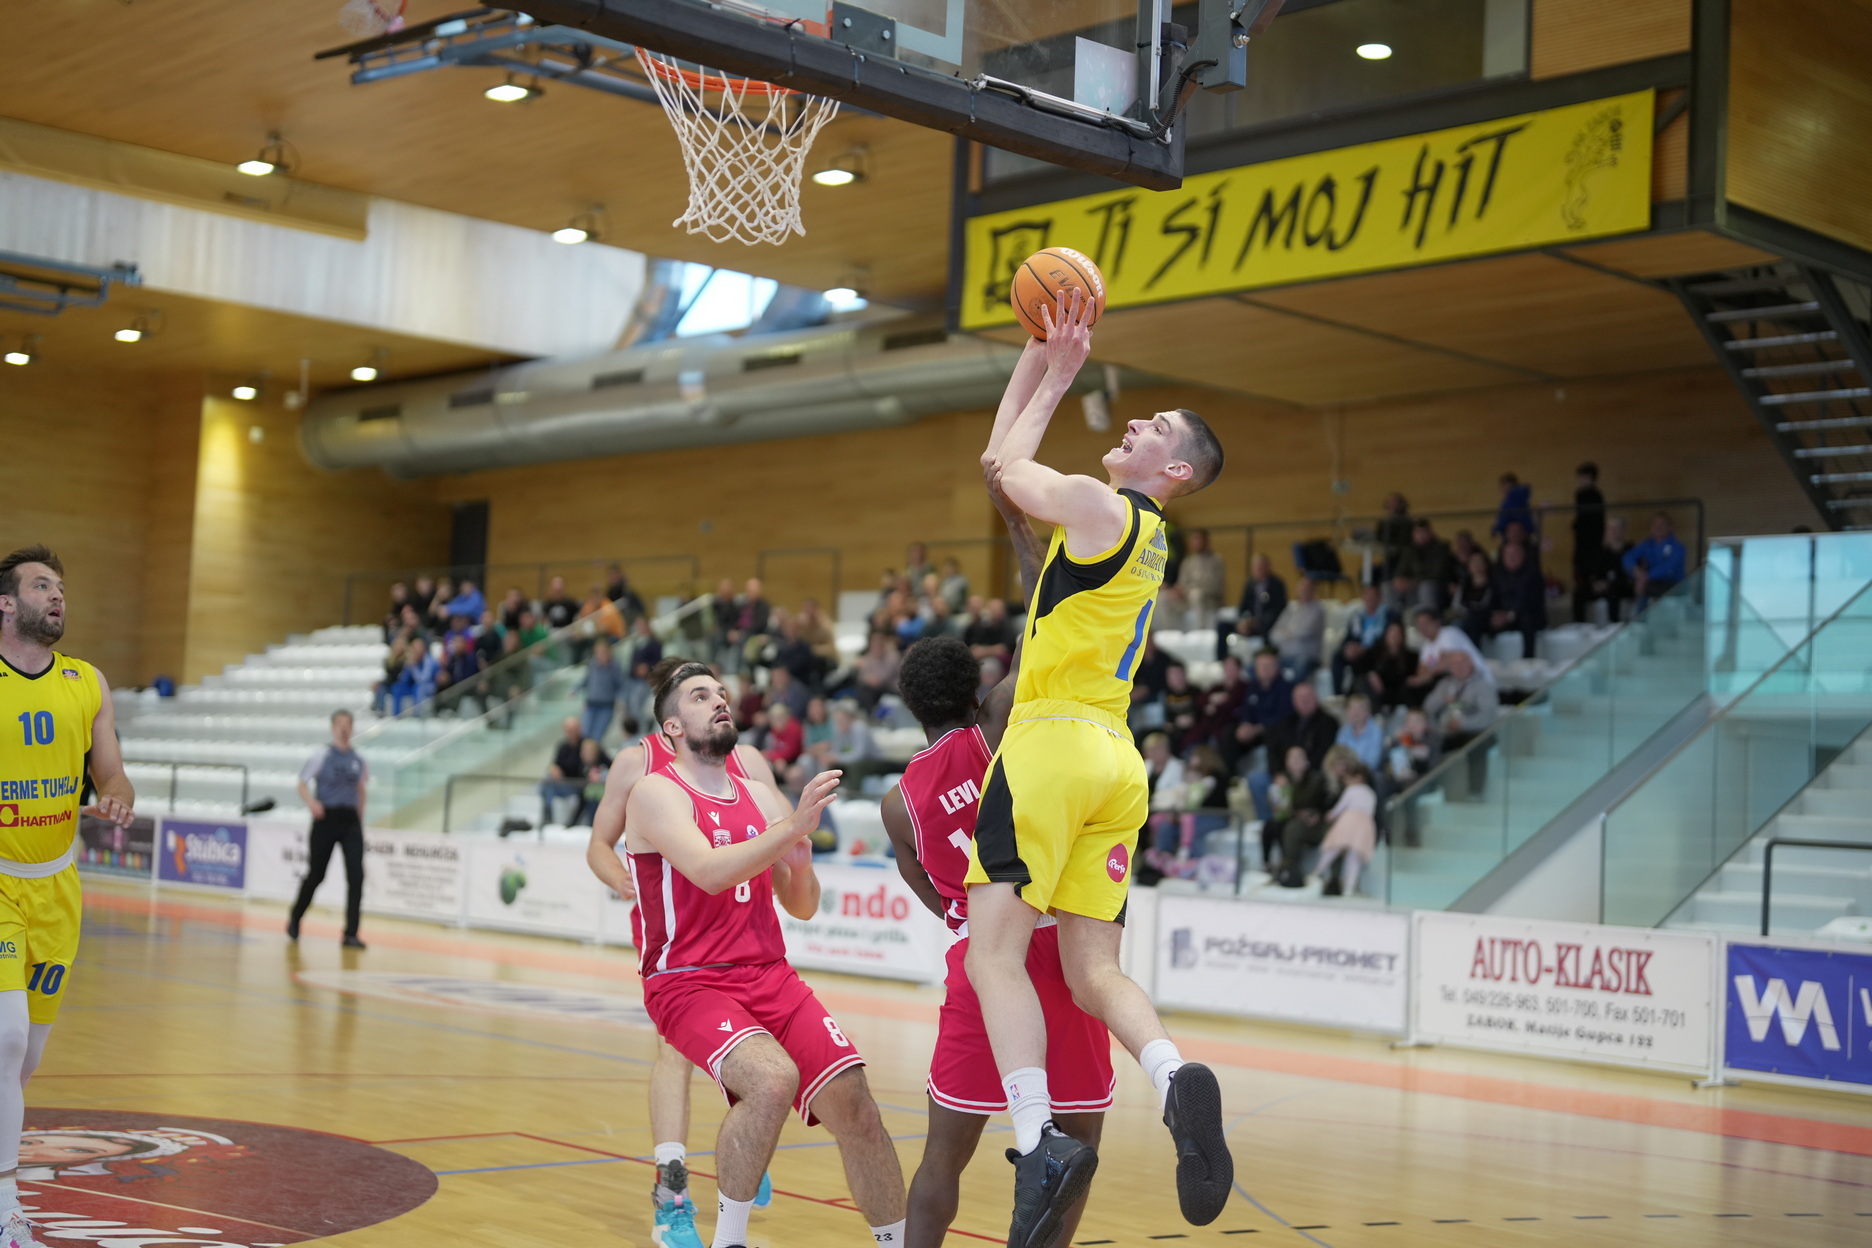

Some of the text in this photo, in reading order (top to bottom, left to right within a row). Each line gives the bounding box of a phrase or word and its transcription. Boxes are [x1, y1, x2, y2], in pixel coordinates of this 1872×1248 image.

[1232, 164, 1381, 275] MOJ
[1115, 599, 1153, 681] 1
[18, 711, 54, 746] 10
[1, 779, 39, 801] ERME
[938, 779, 981, 815] LEVI
[27, 962, 66, 995] 10
[1470, 936, 1654, 996] AUTO-KLASIK
[823, 1016, 849, 1047] 8
[1605, 1002, 1628, 1021] Fax
[1633, 1006, 1686, 1028] 501-701
[875, 1233, 893, 1242] 23
